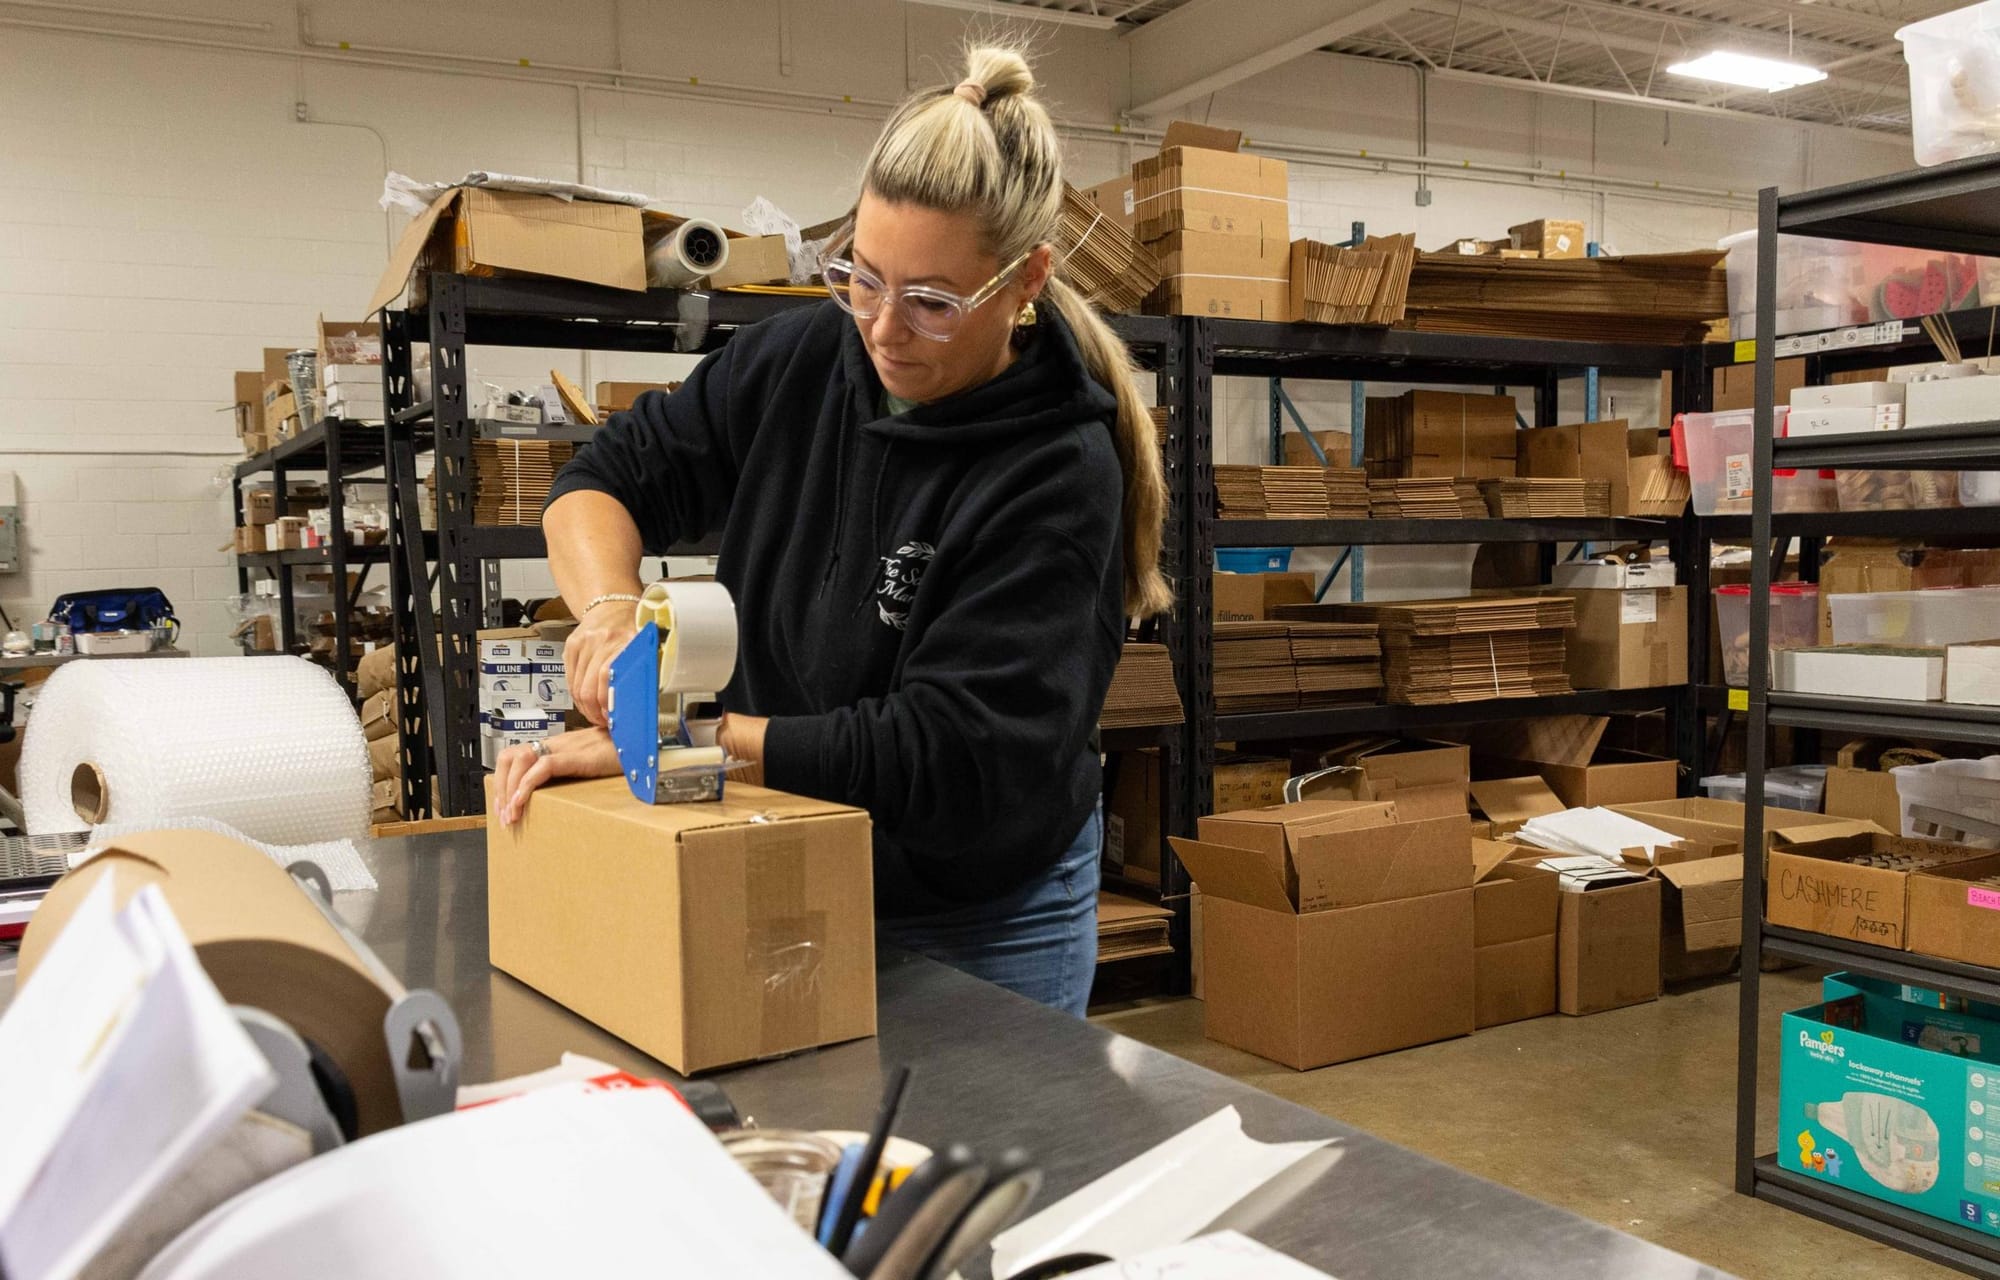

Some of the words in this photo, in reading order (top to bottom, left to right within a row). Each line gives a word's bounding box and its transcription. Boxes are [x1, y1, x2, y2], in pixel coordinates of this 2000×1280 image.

[496, 664, 521, 673] ULINE
[514, 721, 539, 729] ULINE
[1780, 869, 1879, 912] CASHMERE
[1800, 1031, 1845, 1057] Pampers
[1966, 1204, 1975, 1216] 5
